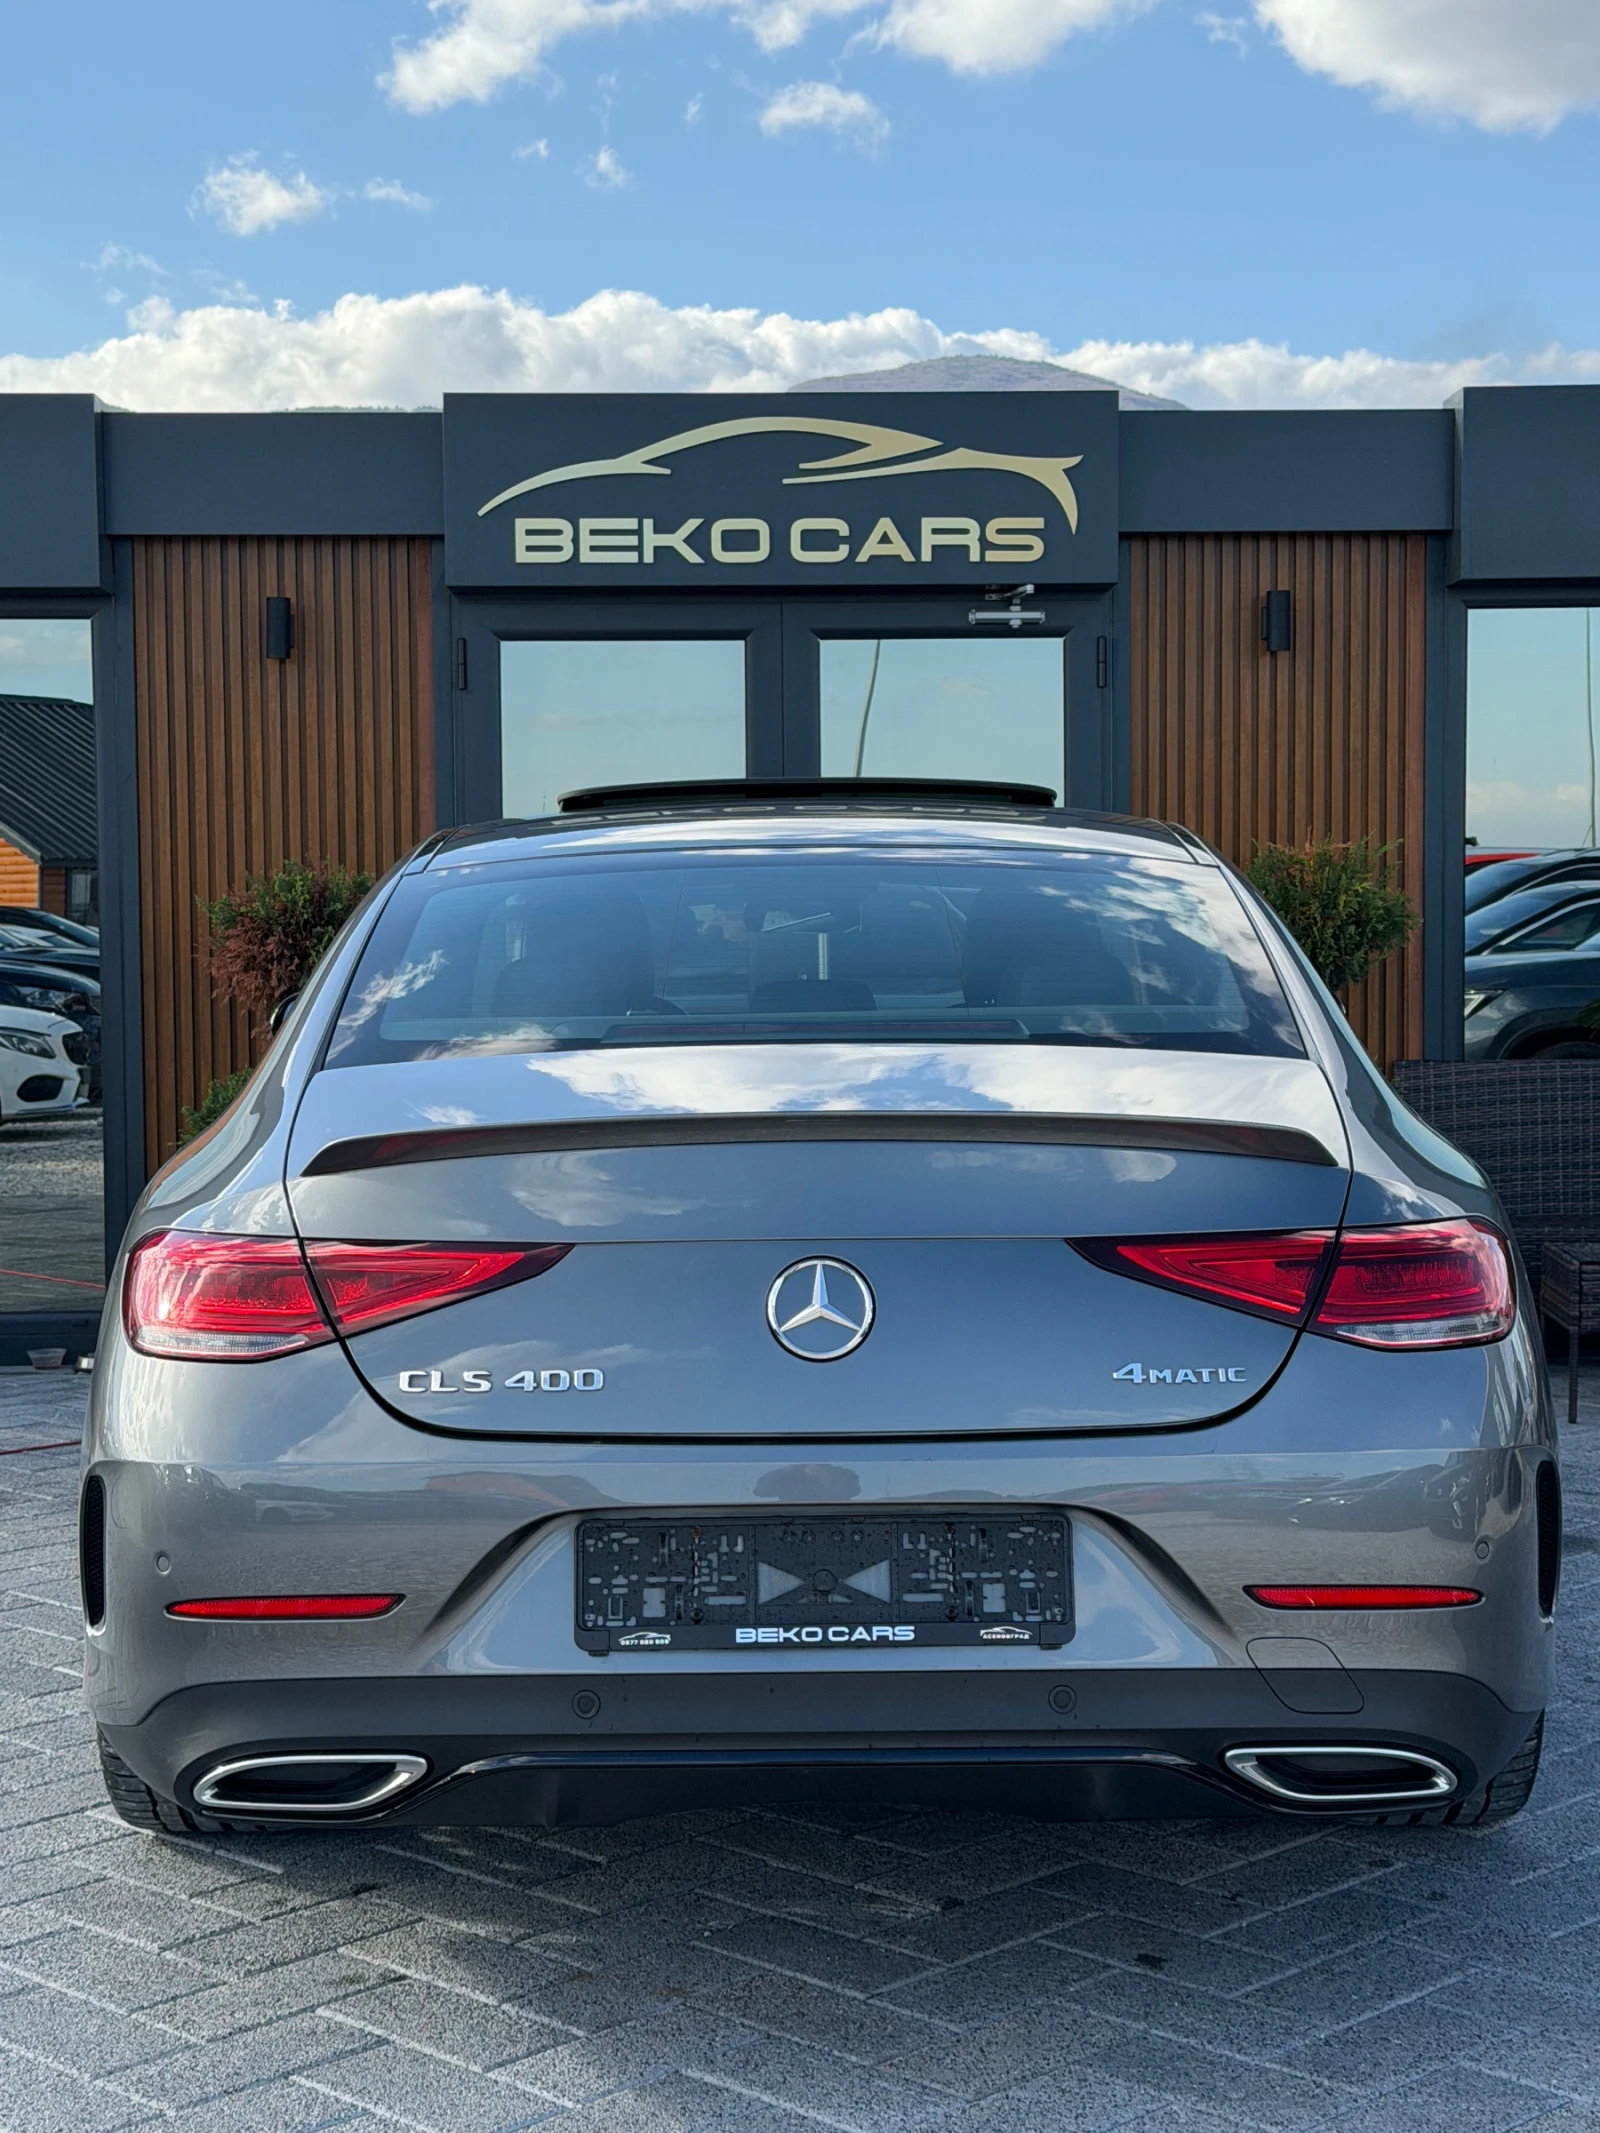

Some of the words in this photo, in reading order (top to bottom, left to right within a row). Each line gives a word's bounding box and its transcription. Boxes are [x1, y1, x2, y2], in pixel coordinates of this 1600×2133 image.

[514, 517, 770, 563] BEKO
[790, 516, 1045, 563] CARS
[399, 1370, 492, 1393] CLS
[505, 1369, 603, 1392] 400
[1113, 1362, 1247, 1384] 4MATIC
[735, 1627, 823, 1643] BEKO
[828, 1626, 915, 1642] CARS
